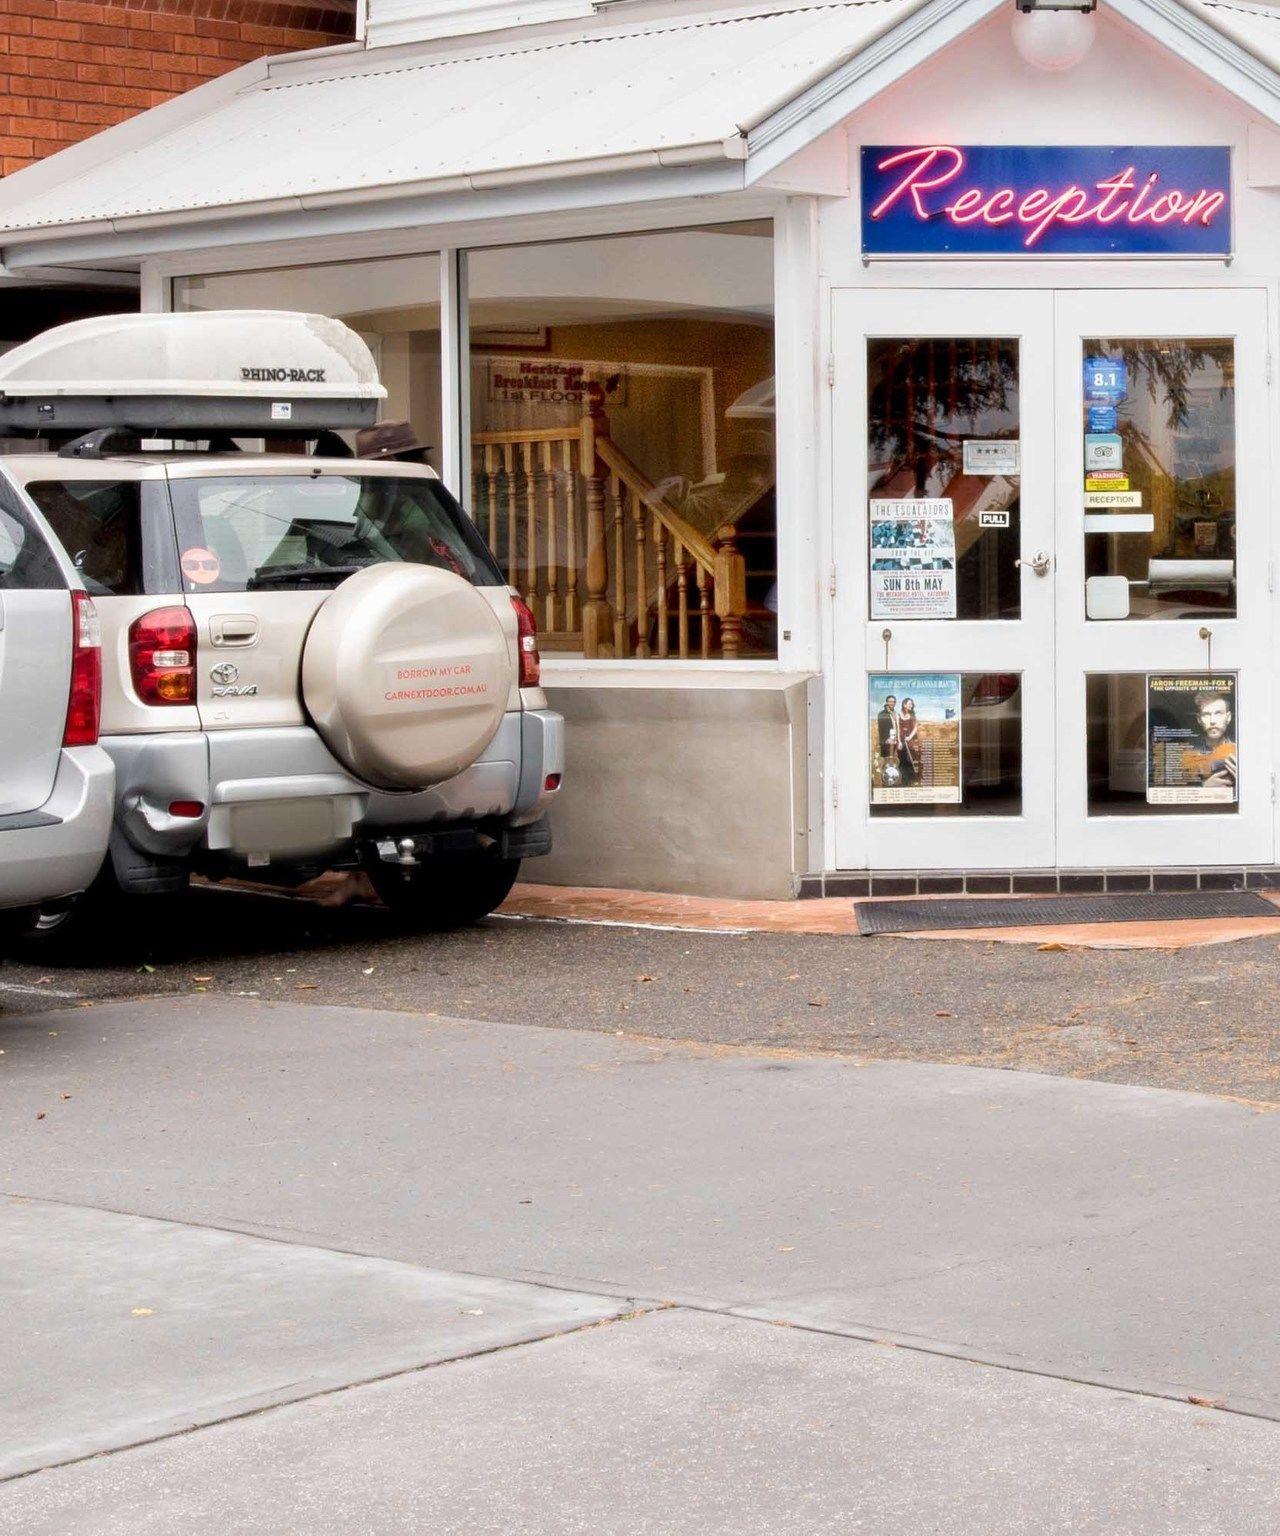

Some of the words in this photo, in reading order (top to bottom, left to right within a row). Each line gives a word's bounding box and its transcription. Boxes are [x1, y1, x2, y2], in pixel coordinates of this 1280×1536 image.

[871, 146, 1225, 246] Reception
[520, 363, 584, 376] Heritage
[494, 374, 558, 390] Breakfast
[1094, 373, 1117, 386] 8.1
[1091, 471, 1124, 479] WARNING
[1089, 496, 1134, 504] RECEPTION
[876, 505, 891, 516] THE
[895, 505, 949, 517] ESCALATORS
[983, 514, 1005, 524] PULL
[883, 578, 901, 591] SUN
[905, 578, 920, 591] 8th
[924, 578, 943, 590] MAY
[397, 668, 437, 680] BORROW
[439, 667, 452, 677] MY
[453, 665, 471, 675] CAR
[211, 684, 258, 698] RAV4
[384, 683, 487, 701] CARNEXTDOOR.COM.AU
